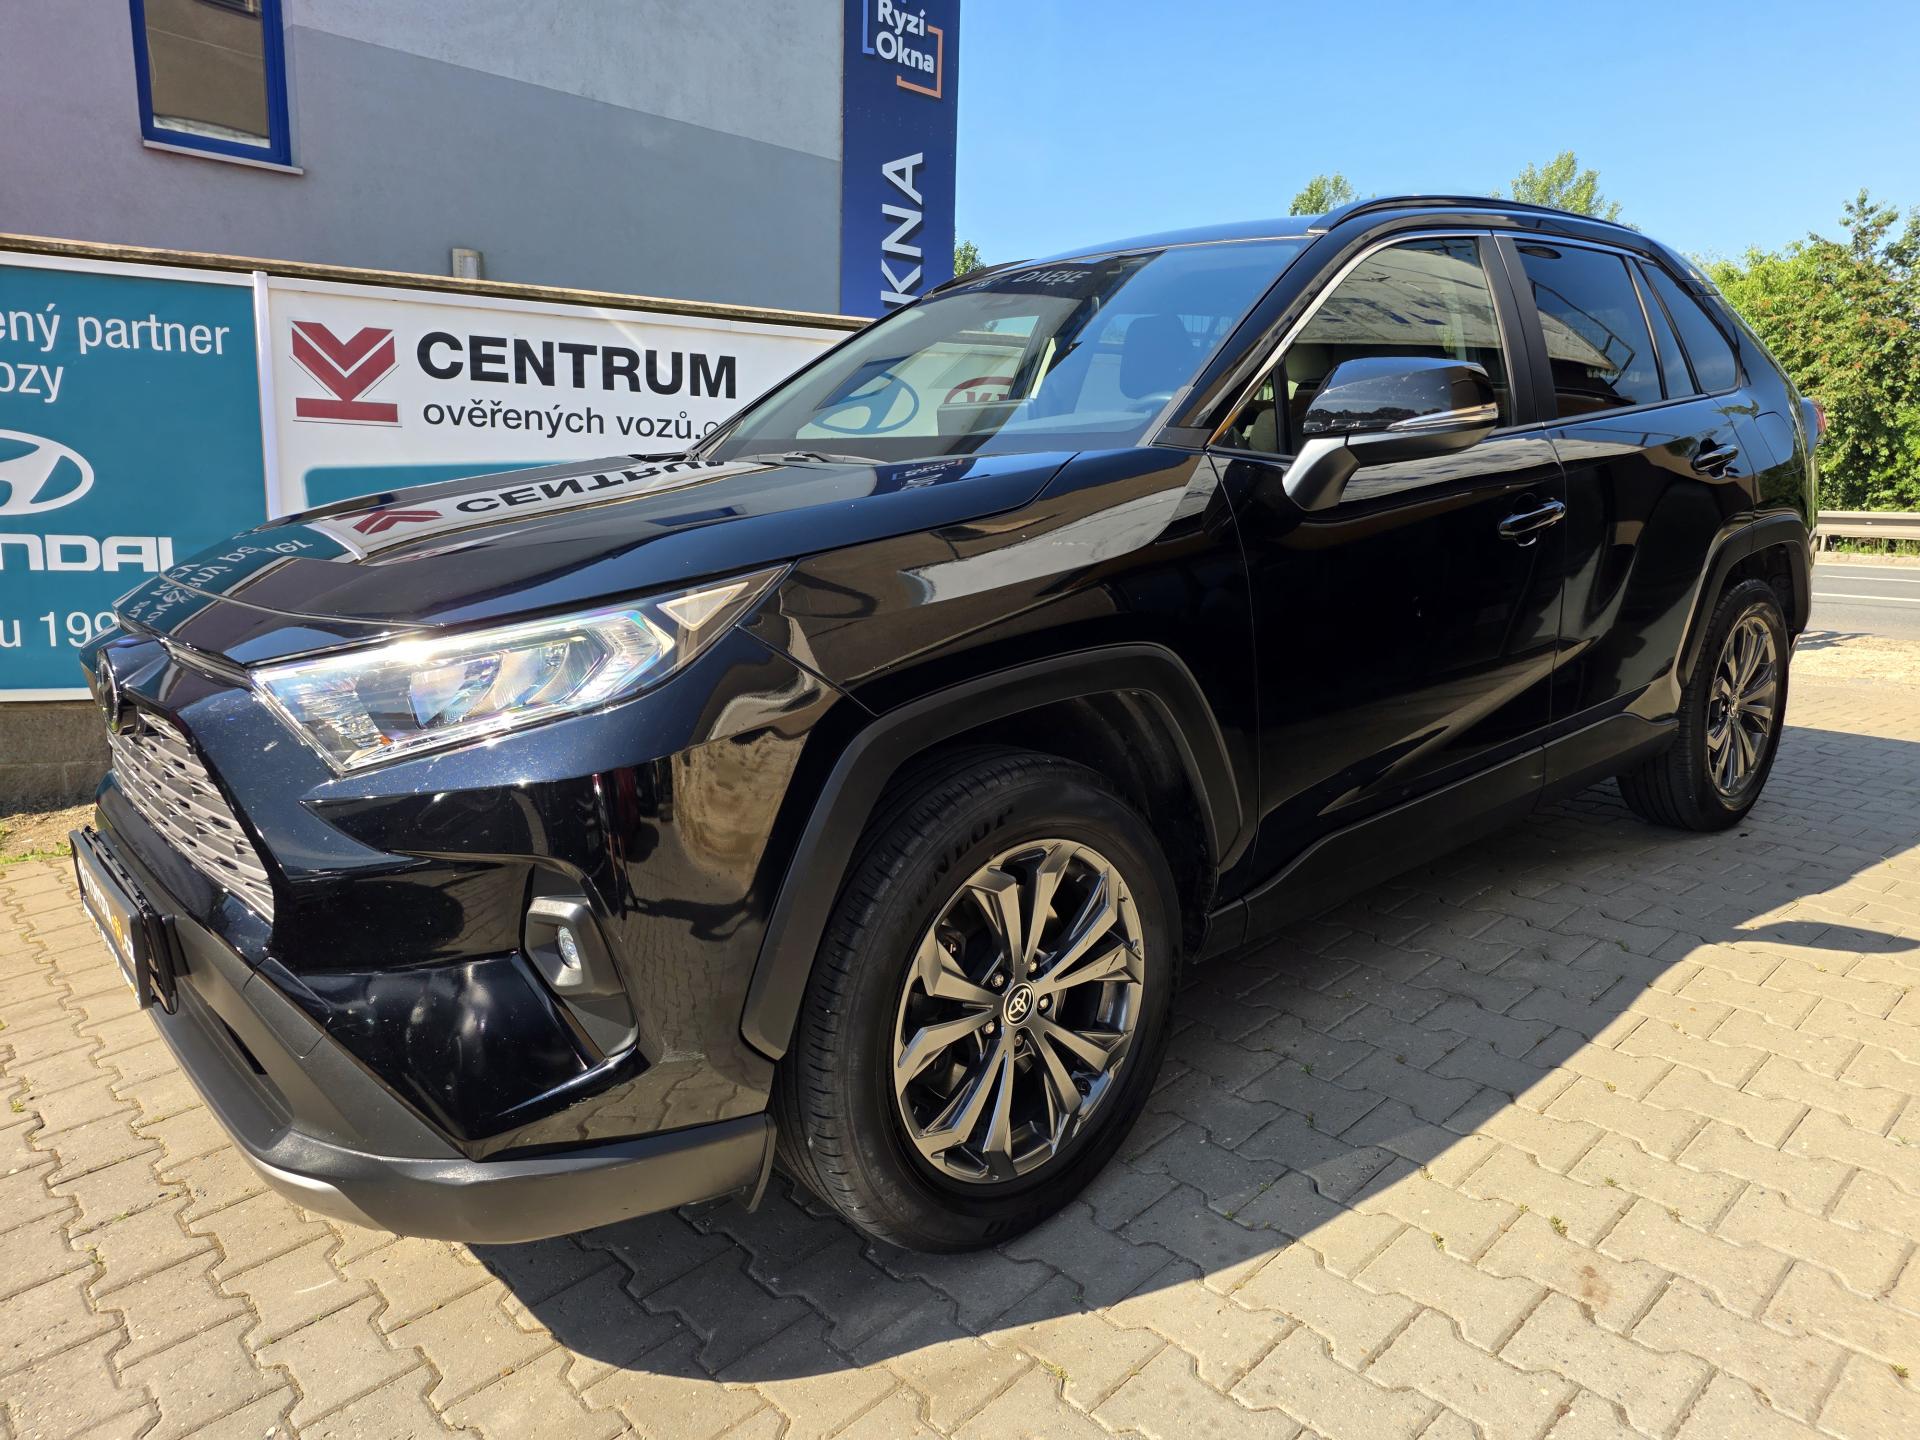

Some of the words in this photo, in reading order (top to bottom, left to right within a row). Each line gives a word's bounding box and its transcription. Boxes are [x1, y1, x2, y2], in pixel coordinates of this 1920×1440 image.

[876, 31, 934, 73] Okna
[880, 152, 923, 305] KNA
[0, 303, 60, 352] ný
[77, 313, 230, 355] partner
[0, 361, 64, 403] ozy
[416, 331, 737, 399] CENTRUM
[422, 399, 605, 437] ověřených
